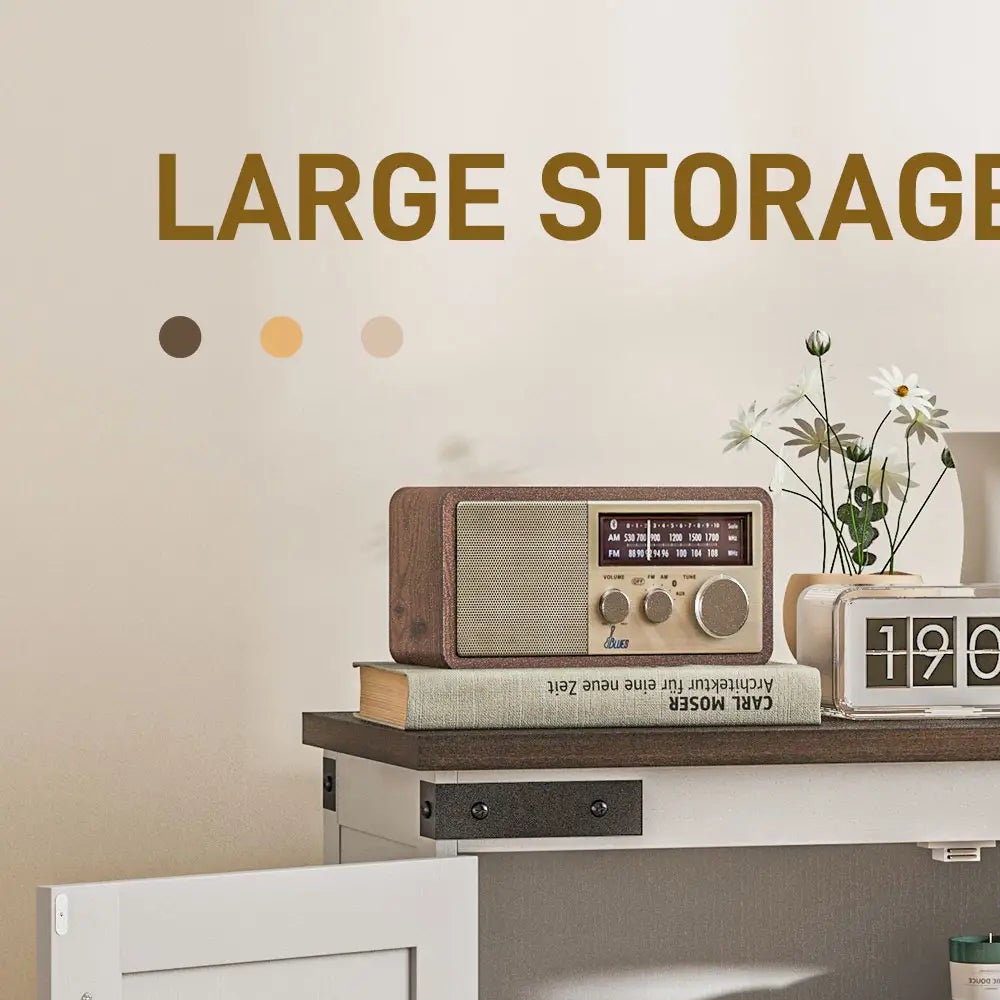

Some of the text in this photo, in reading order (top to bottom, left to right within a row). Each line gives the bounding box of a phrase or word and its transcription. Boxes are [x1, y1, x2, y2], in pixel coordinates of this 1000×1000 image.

[608, 533, 620, 541] AM
[624, 533, 634, 542] 530
[636, 533, 646, 542] 700
[669, 533, 682, 542] 1200
[688, 533, 702, 542] 1500
[705, 533, 719, 542] 1700
[608, 549, 620, 558] FM
[661, 549, 669, 558] 96
[676, 549, 687, 558] 100
[691, 549, 702, 558] 104
[707, 549, 719, 558] 108
[547, 678, 773, 696] Architektur für eine neue Zeit
[669, 696, 773, 711] CARL MOSER
